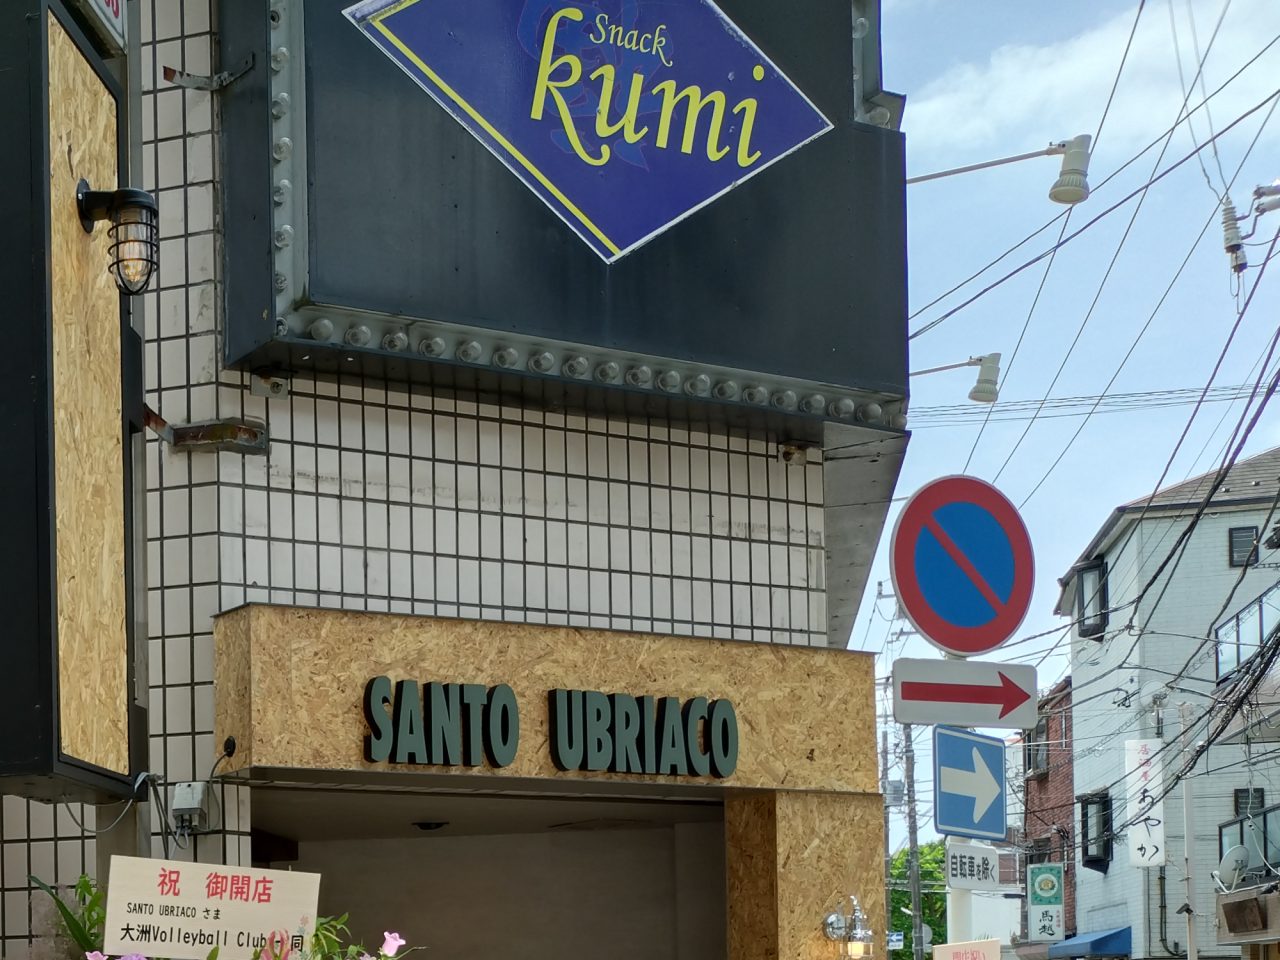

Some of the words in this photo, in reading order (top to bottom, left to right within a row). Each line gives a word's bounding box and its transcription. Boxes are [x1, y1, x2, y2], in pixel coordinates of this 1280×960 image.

[589, 13, 674, 67] Snack
[529, 7, 766, 168] kumi
[363, 675, 520, 768] SANTO
[548, 687, 739, 778] UBRIACO
[951, 853, 996, 882] 自転車を除く
[157, 867, 181, 897] 祝
[205, 871, 274, 904] 御開店
[126, 902, 154, 915] SANTO
[159, 904, 197, 919] UBRIACO
[202, 907, 221, 920] さま
[1038, 910, 1056, 936] 馬越
[120, 922, 228, 947] 大洲Volleyball
[237, 931, 267, 949] Club
